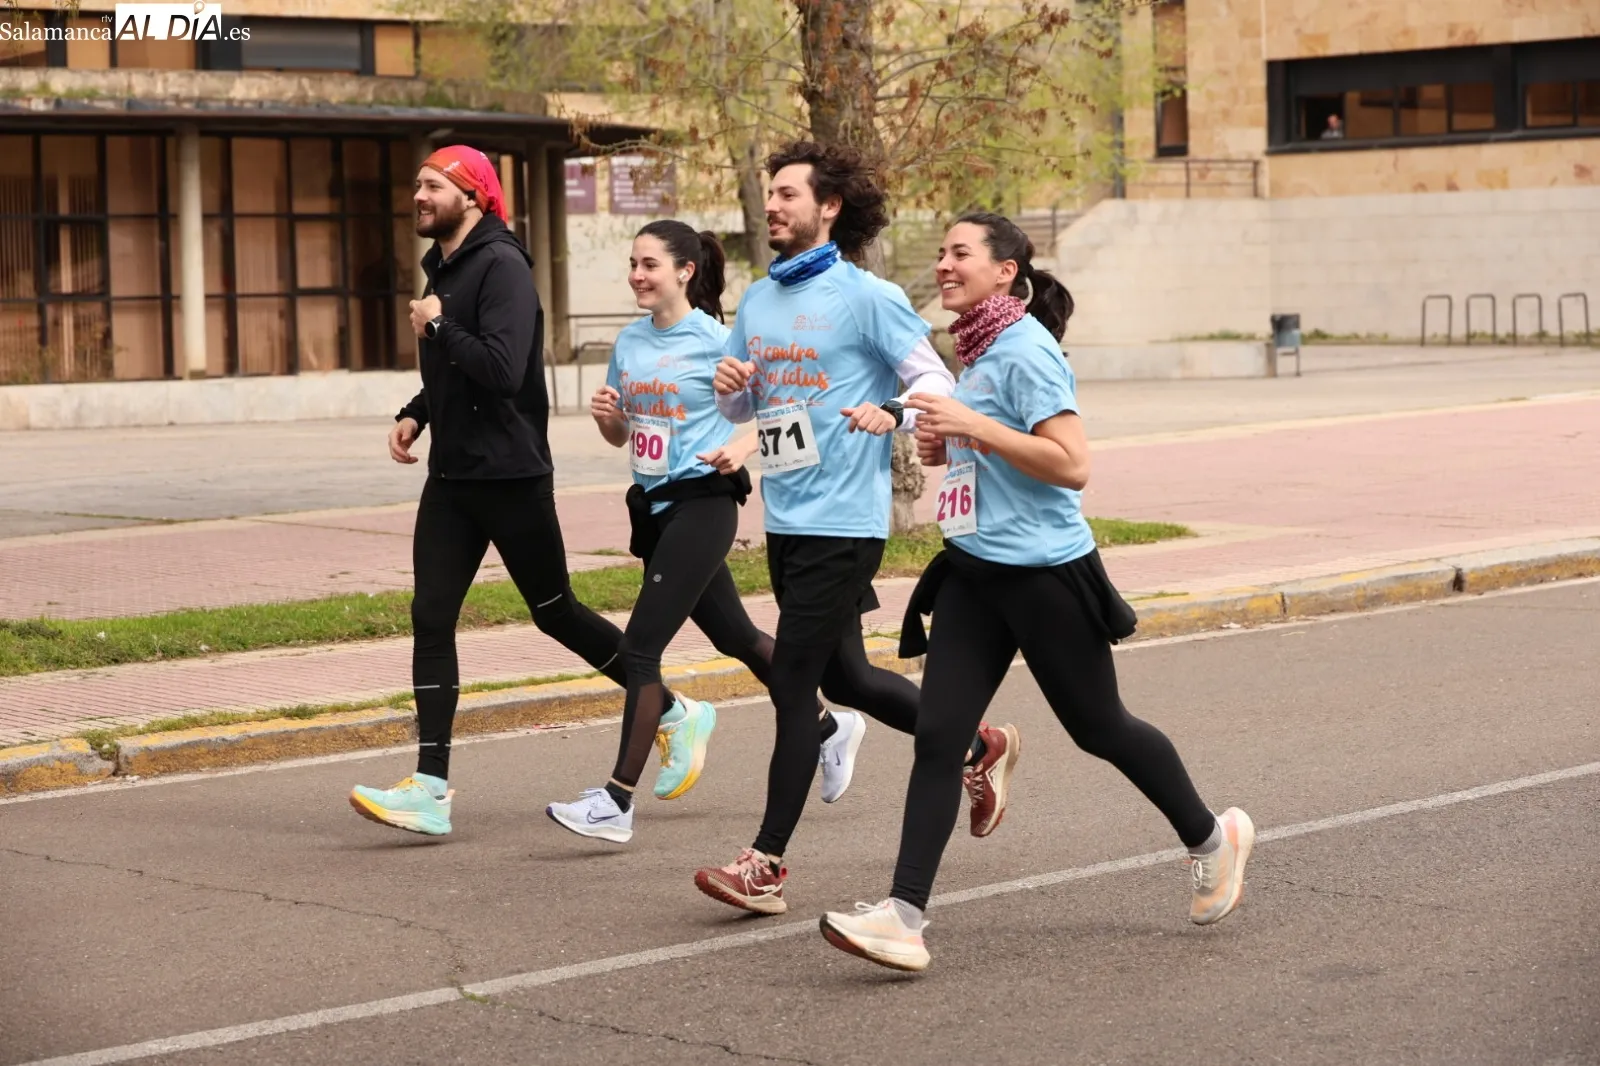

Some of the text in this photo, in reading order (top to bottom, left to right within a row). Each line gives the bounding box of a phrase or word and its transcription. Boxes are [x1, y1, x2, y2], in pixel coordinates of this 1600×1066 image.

[764, 341, 819, 362] contra
[629, 376, 680, 397] contra
[767, 365, 831, 391] el ictus
[630, 430, 664, 461] 190
[758, 421, 806, 457] 371
[937, 484, 972, 522] 216
